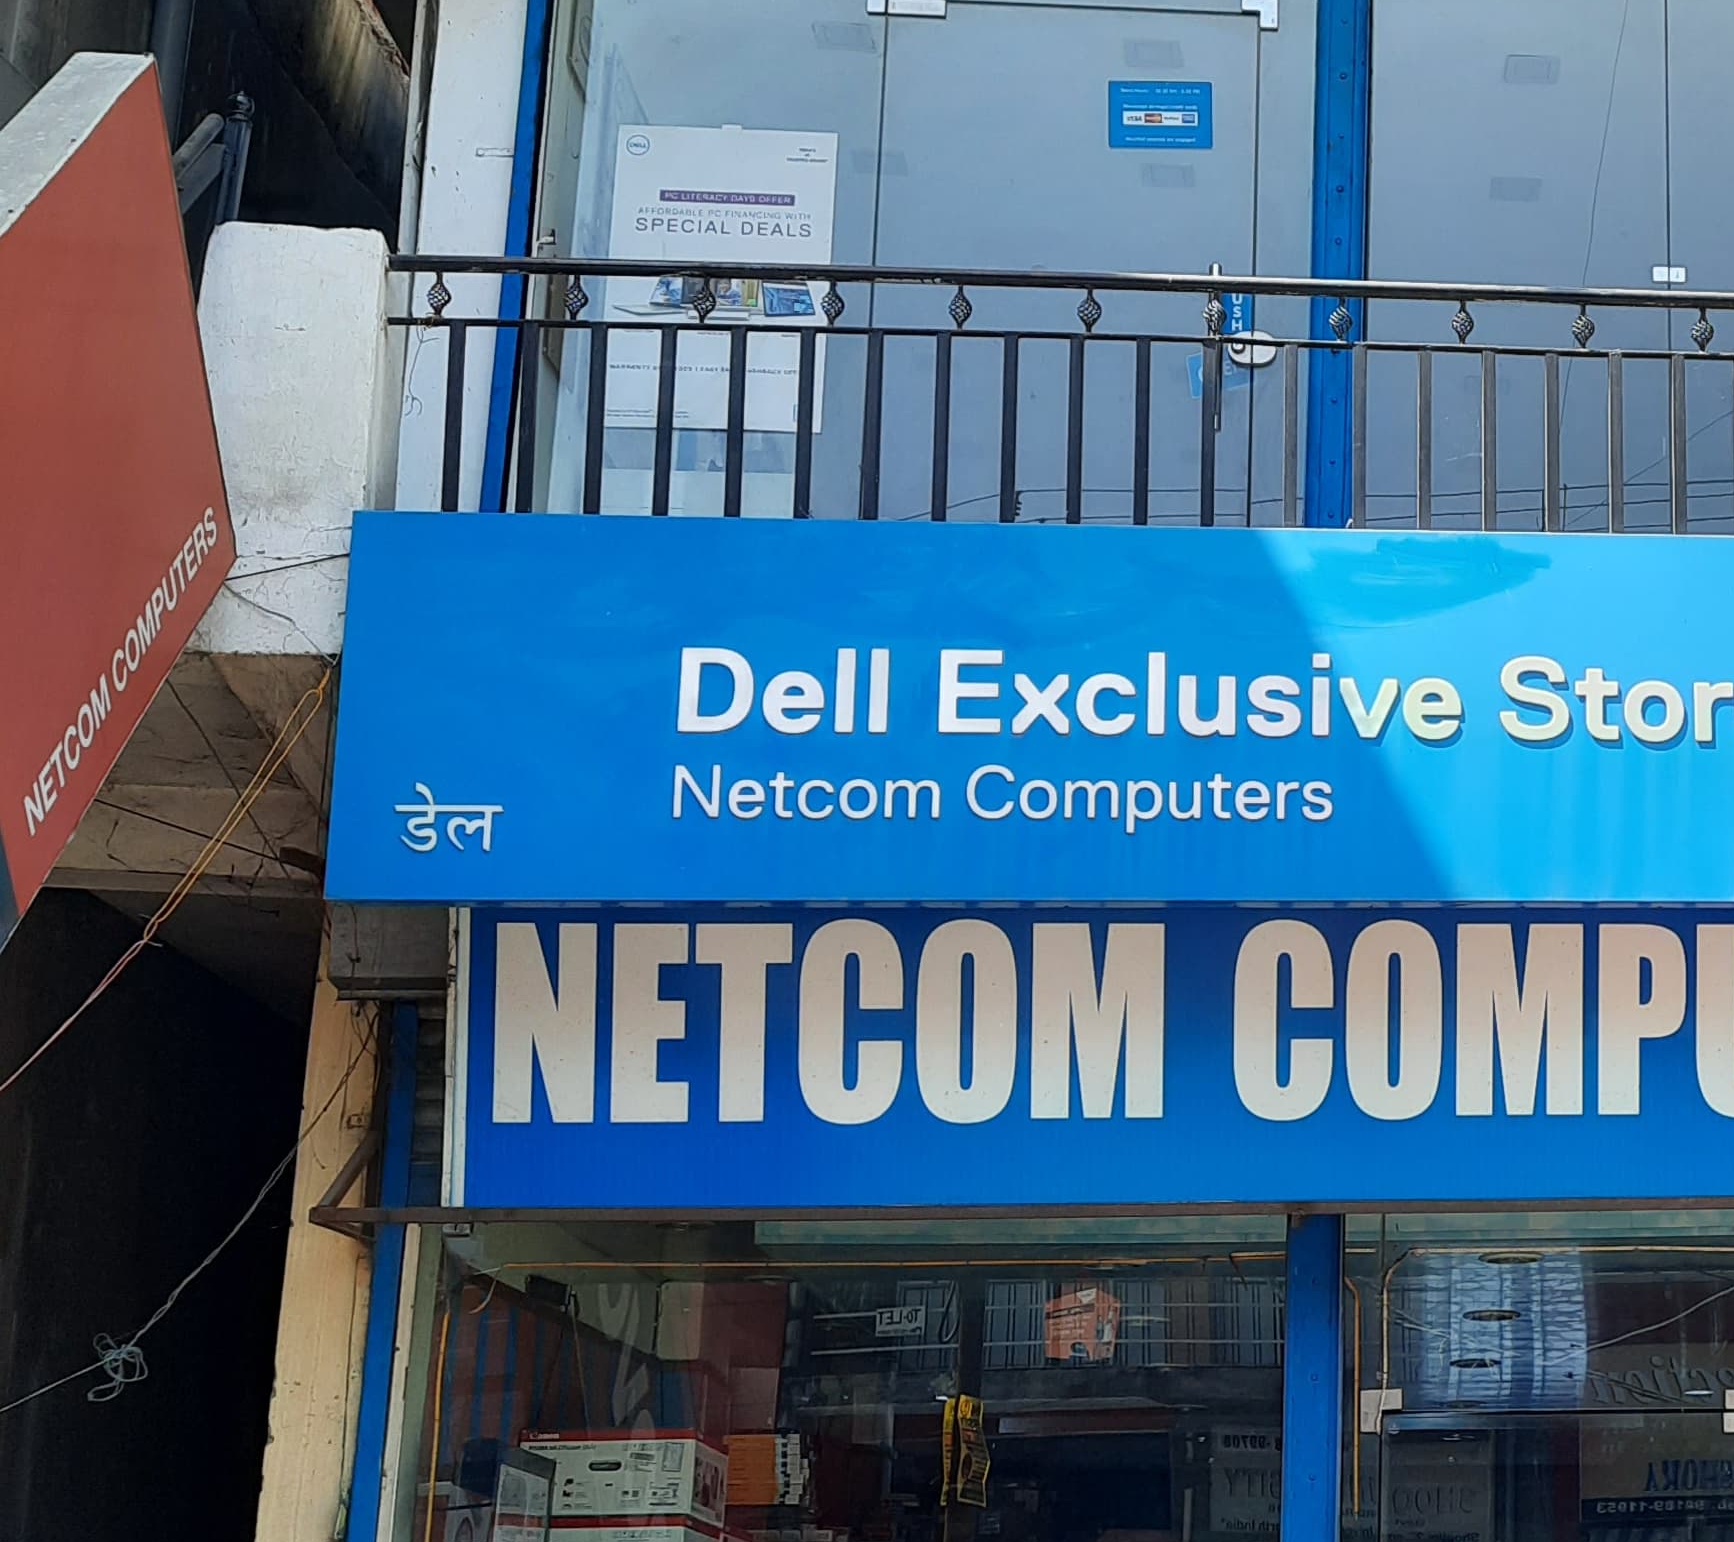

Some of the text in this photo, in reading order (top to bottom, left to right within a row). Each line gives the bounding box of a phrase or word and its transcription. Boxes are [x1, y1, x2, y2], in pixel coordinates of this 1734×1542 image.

[635, 216, 813, 238] SPECIAL DEALS
[638, 206, 703, 217] AFFORDABLE
[724, 210, 782, 220] FINANCING
[758, 196, 793, 205] OFFER
[1231, 292, 1243, 332] USH
[22, 506, 218, 837] NETCOM COMPUTERS
[676, 646, 890, 736] Dell
[936, 648, 1464, 743] Exclusive
[394, 782, 504, 854] डेल
[671, 763, 1334, 835] Netcom Computers
[491, 917, 1166, 1126] NETCOM
